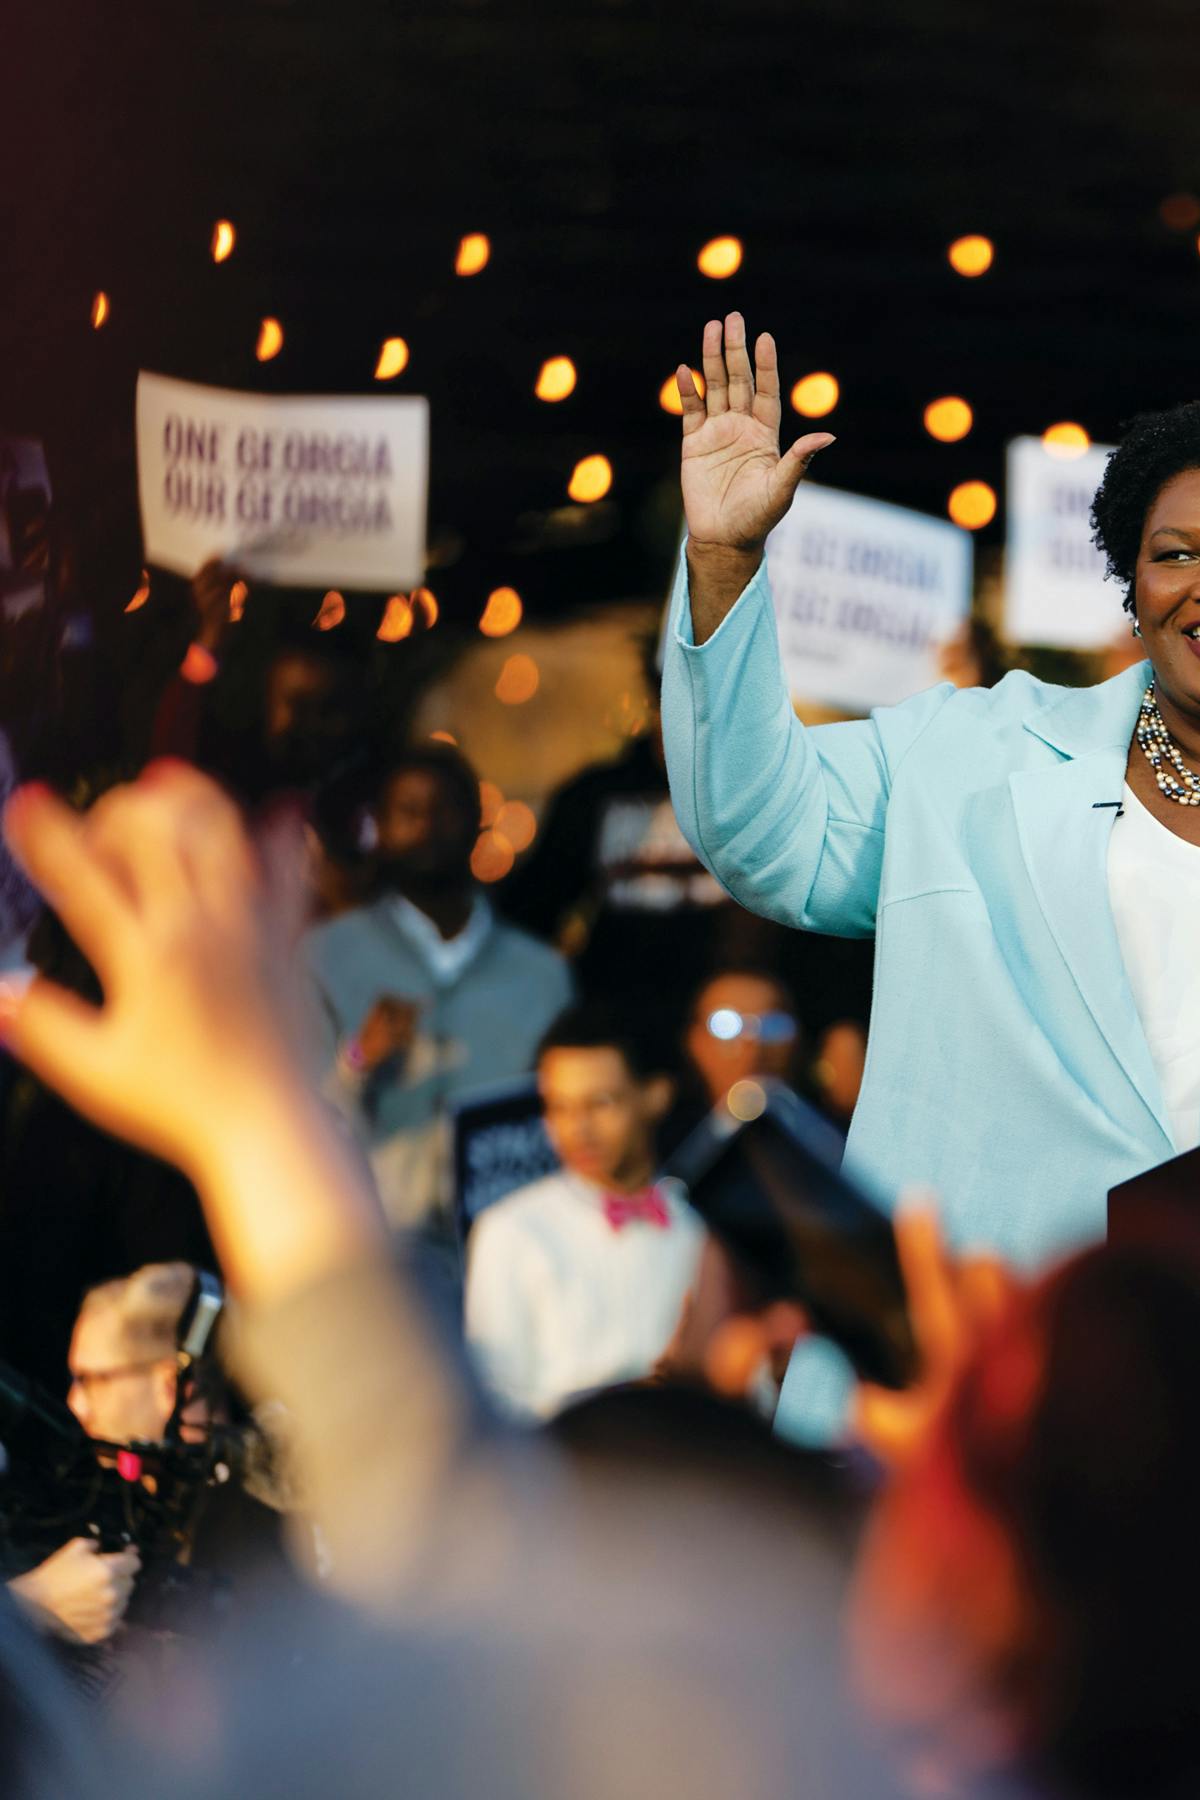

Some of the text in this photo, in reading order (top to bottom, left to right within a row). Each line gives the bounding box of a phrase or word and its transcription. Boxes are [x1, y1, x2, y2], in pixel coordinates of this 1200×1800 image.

[162, 412, 393, 479] ONE GEORGIA
[162, 466, 393, 531] OUR GEORGIA
